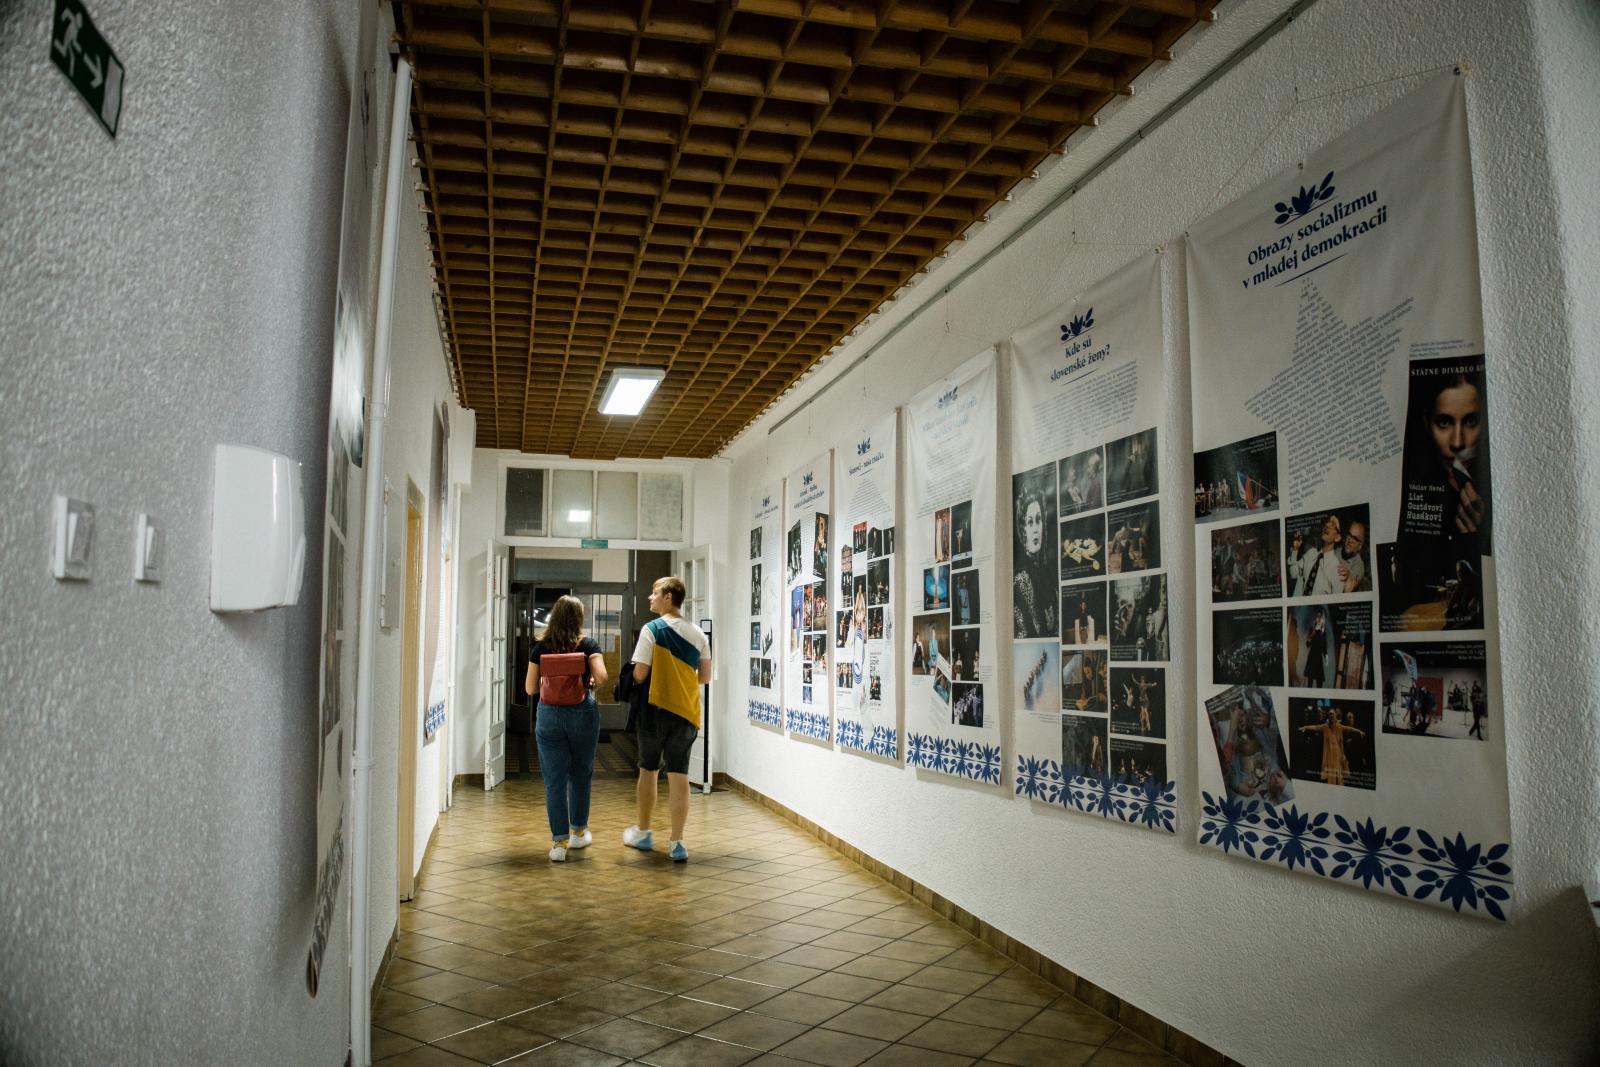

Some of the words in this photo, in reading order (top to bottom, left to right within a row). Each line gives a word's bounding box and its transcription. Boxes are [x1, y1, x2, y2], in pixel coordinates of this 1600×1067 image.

[1247, 232, 1294, 266] Obrazy
[1297, 189, 1378, 241] socializmu
[1242, 277, 1250, 289] v
[1252, 249, 1298, 286] mladej
[1301, 204, 1387, 262] demokracii
[1065, 342, 1081, 358] Kde
[1082, 334, 1092, 350] sú
[1050, 355, 1087, 382] slovenské
[1087, 343, 1110, 365] ženy?
[1441, 365, 1475, 375] DIVADLO
[1428, 485, 1446, 493] Havel
[1407, 491, 1424, 502] List
[1407, 501, 1444, 512] Gustávovi
[1405, 510, 1443, 522] Husákovi
